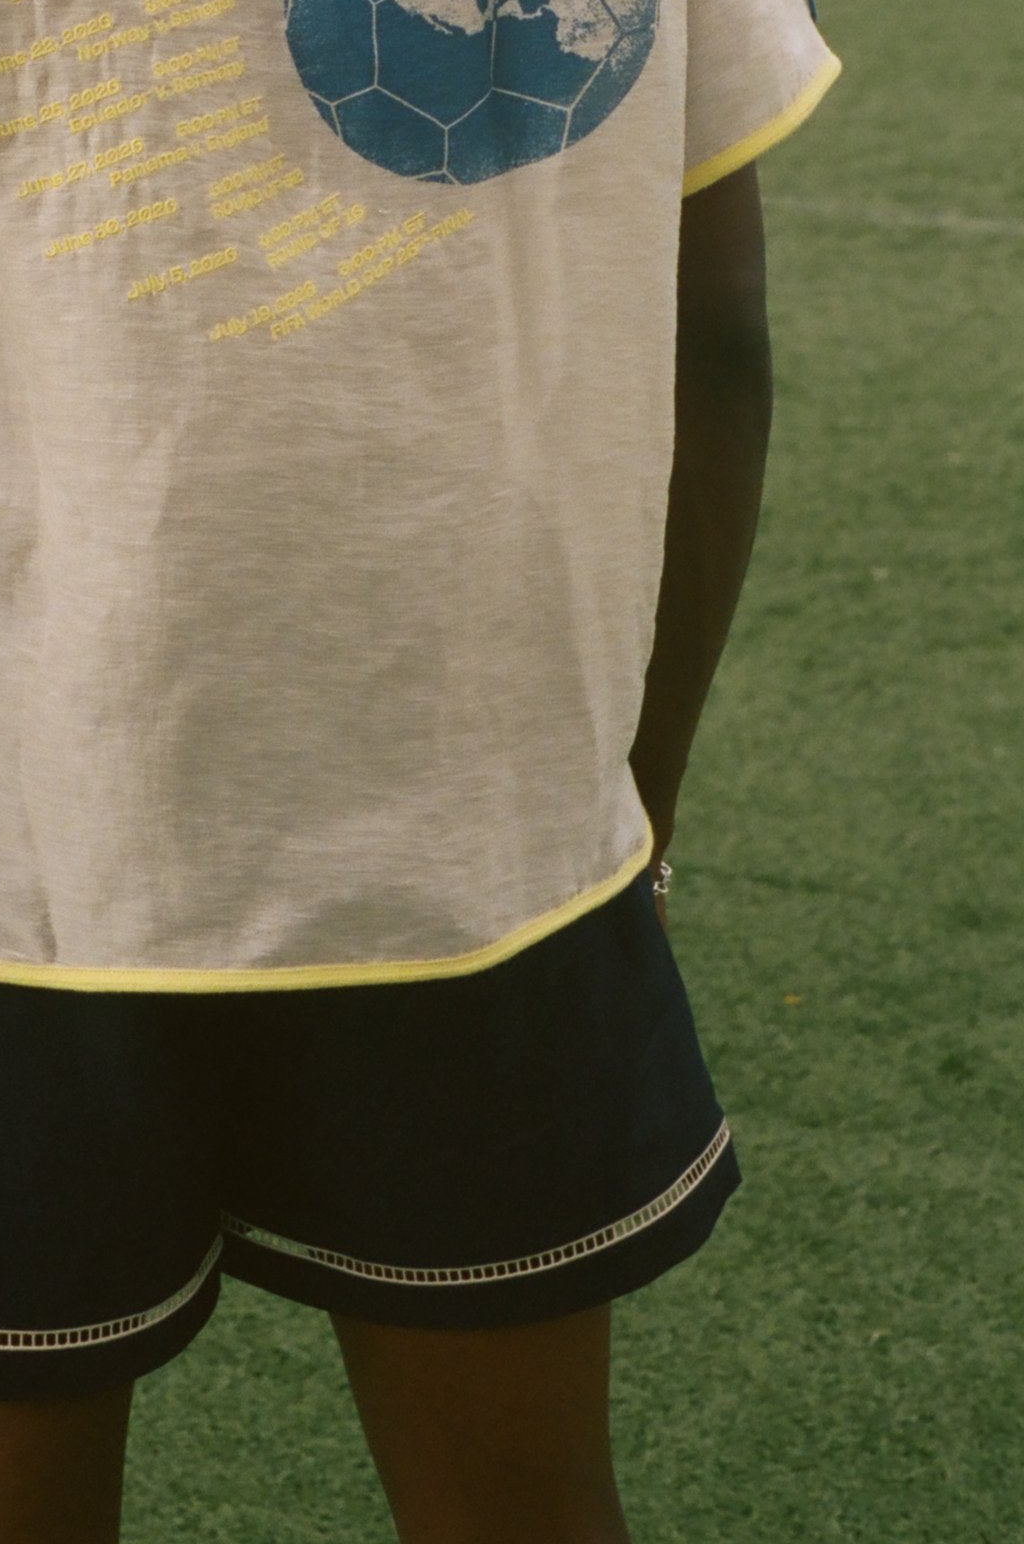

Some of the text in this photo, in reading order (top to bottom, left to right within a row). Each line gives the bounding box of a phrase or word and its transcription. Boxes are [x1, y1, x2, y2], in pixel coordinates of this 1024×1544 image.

[63, 13, 113, 44] 2026
[81, 26, 149, 59] Norway
[71, 79, 120, 109] 2026
[72, 90, 151, 132] Ecuador
[173, 62, 245, 92] Germany
[19, 173, 63, 198] June
[97, 138, 144, 169] 2026
[112, 148, 188, 187] Panama
[208, 117, 269, 150] England
[49, 232, 92, 258] June
[129, 198, 176, 227] 2026
[214, 190, 261, 218] ROUND
[129, 275, 166, 301] July
[191, 247, 238, 276] 2026
[269, 234, 318, 267] ROUND
[273, 314, 305, 338] FIFA
[308, 280, 363, 319] WORLD
[434, 211, 473, 238] FINAL
[210, 318, 248, 341] July
[278, 281, 316, 312] 2026
